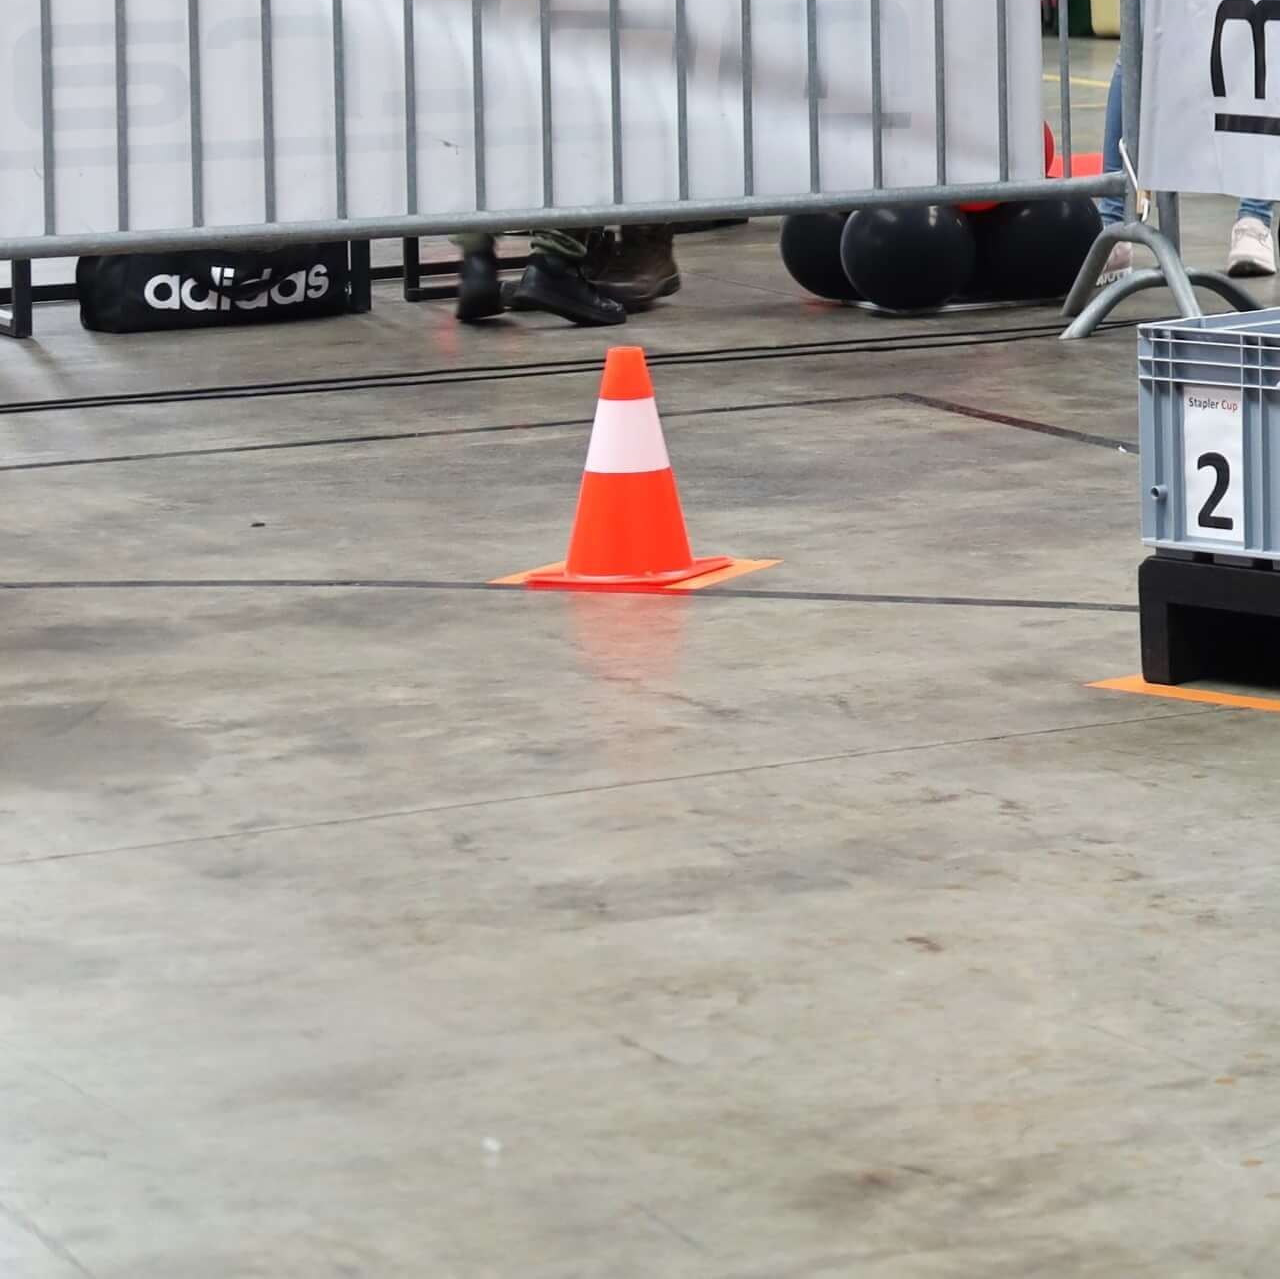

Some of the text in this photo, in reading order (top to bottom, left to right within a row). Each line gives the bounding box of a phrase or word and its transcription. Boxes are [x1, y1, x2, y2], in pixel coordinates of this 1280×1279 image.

[143, 263, 330, 311] adidas
[1188, 396, 1238, 413] Stapler Cup
[1196, 451, 1234, 531] 2
